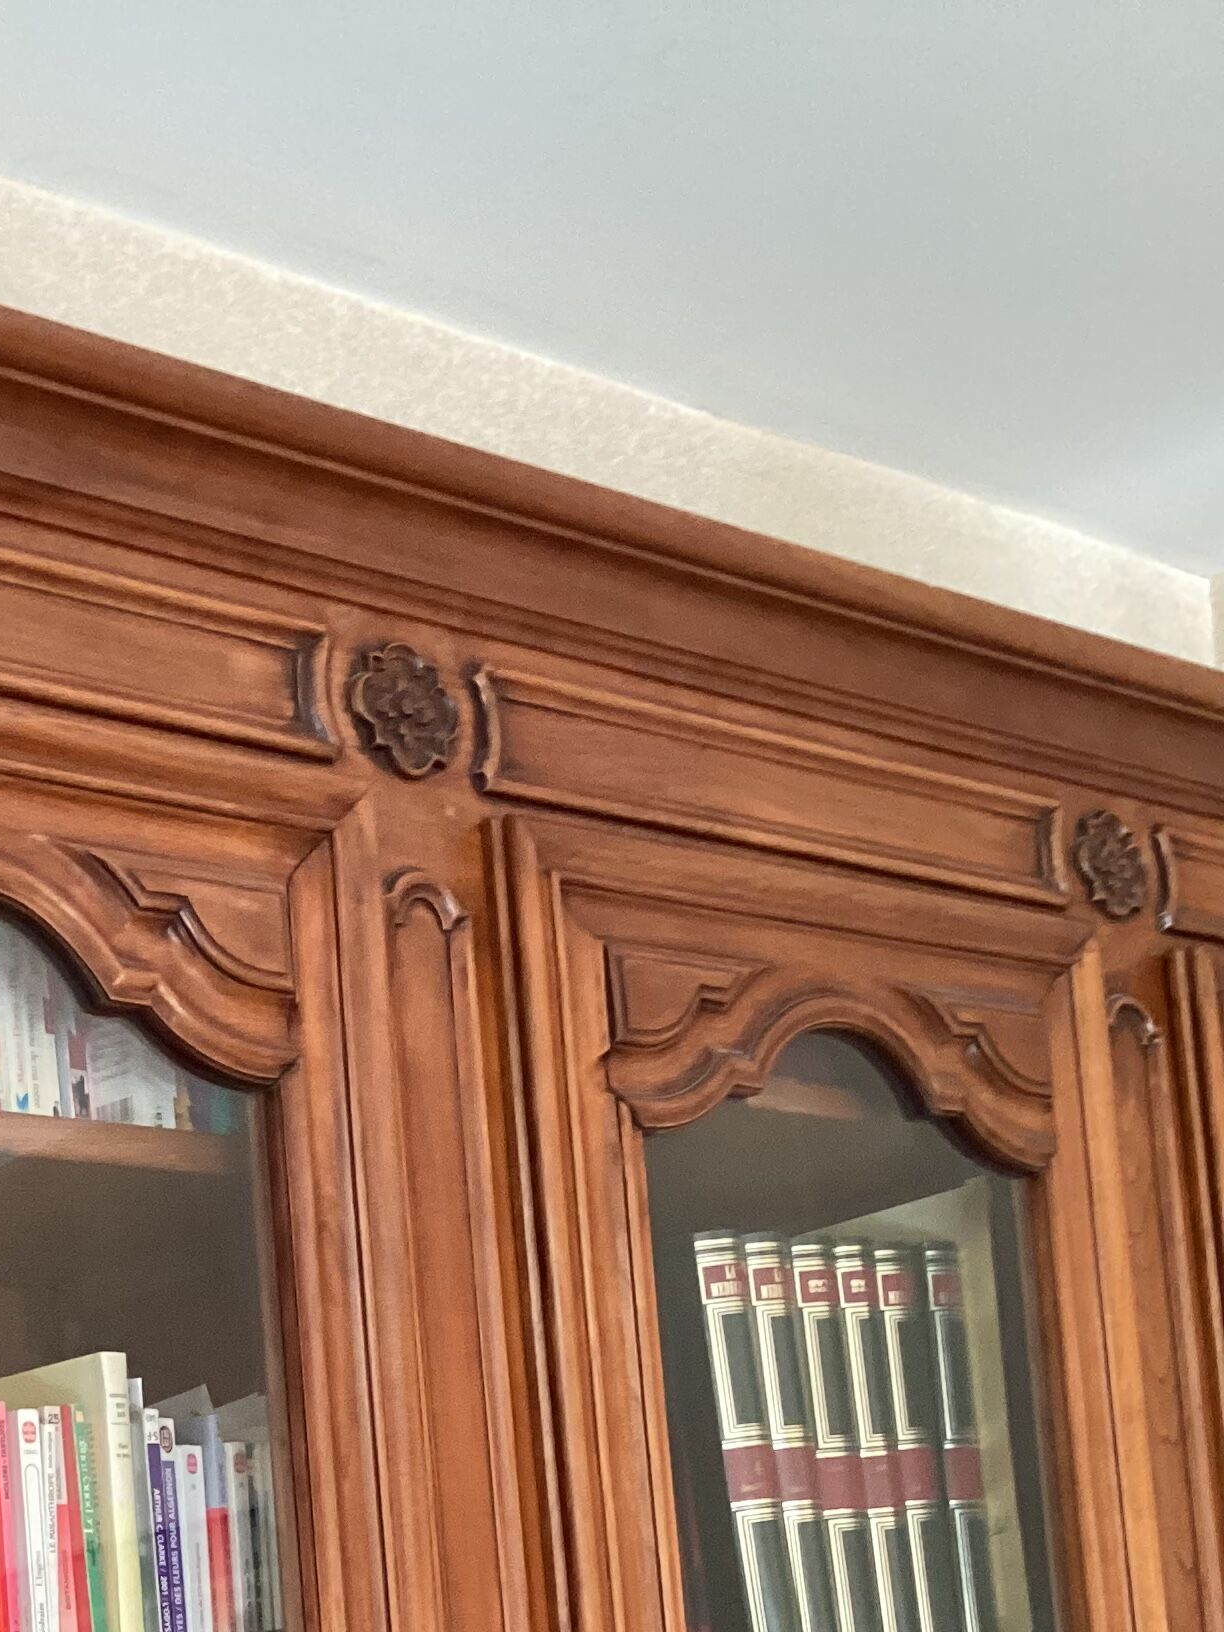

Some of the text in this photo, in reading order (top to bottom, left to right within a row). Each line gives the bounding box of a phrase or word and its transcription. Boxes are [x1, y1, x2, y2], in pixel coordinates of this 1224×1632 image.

[46, 1472, 56, 1540] MISANTHROPE
[153, 1487, 163, 1523] ARTHUR
[163, 1467, 175, 1520] ALGERNON
[156, 1534, 167, 1566] CLARKE
[167, 1521, 177, 1549] POUR
[171, 1550, 181, 1585] FLEURS
[160, 1575, 169, 1596] 2001
[174, 1586, 182, 1605] DES
